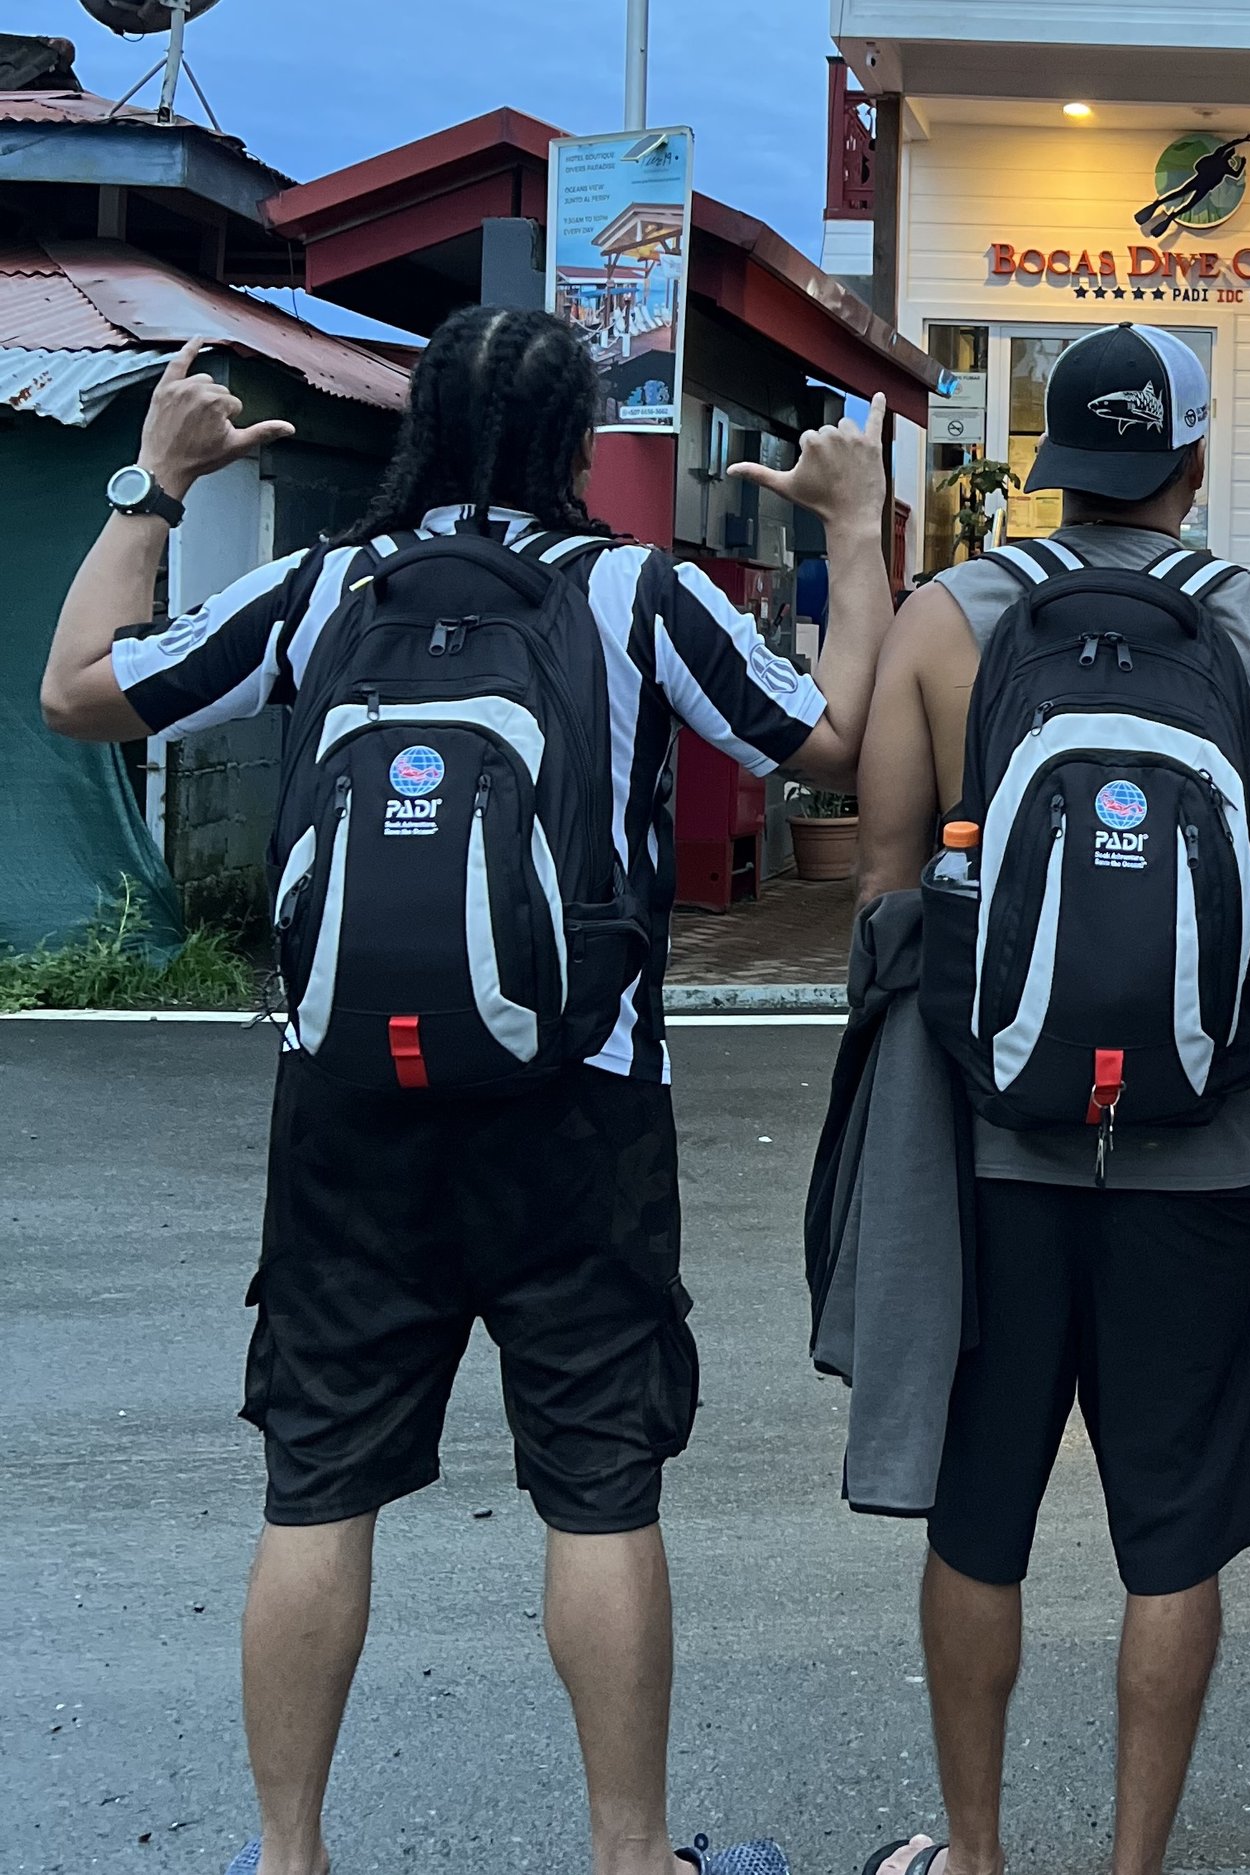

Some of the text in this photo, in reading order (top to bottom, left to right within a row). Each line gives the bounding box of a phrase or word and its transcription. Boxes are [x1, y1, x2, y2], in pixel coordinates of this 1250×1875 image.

[991, 243, 1115, 275] BOCAS
[1127, 246, 1221, 277] DIVE
[1173, 289, 1209, 302] PADI
[1217, 289, 1244, 303] IDC
[385, 798, 442, 818] PADI
[1095, 830, 1149, 852] PADI
